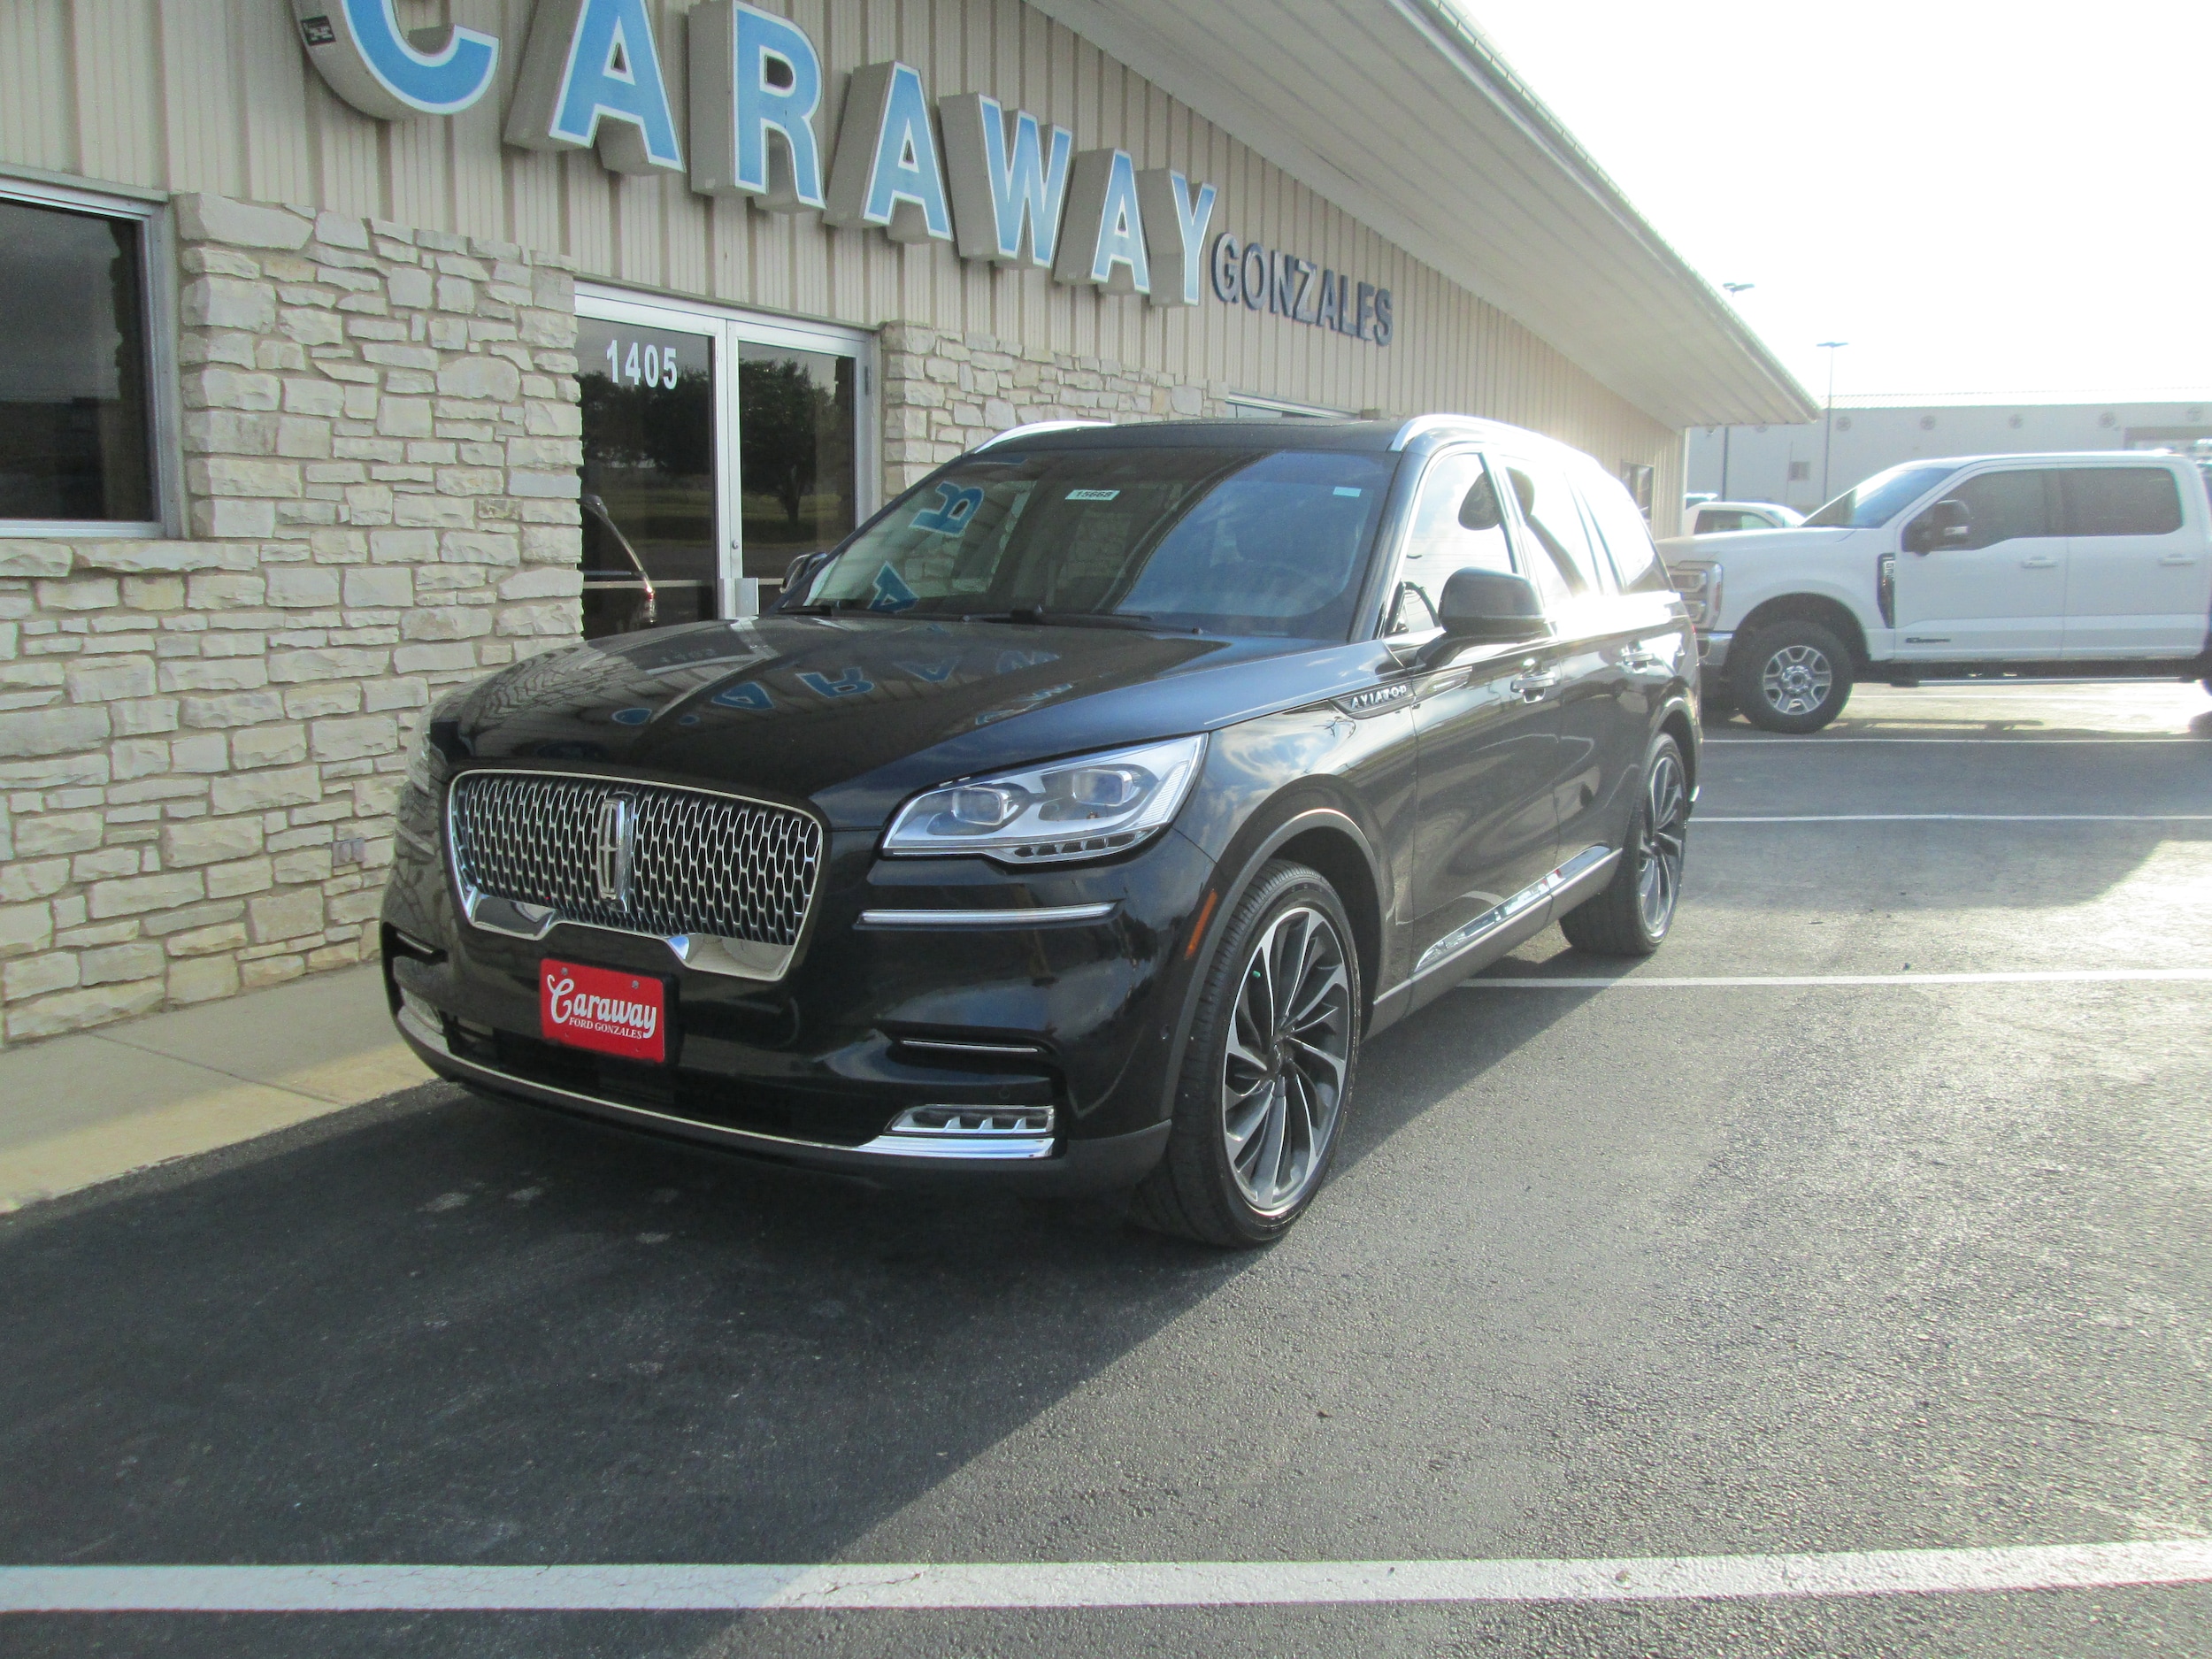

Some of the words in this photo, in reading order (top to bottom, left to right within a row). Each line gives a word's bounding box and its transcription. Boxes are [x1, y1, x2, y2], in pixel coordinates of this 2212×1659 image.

[1211, 232, 1394, 347] GONZALES
[606, 339, 678, 390] 1405
[547, 974, 657, 1039] Caraway
[569, 1018, 594, 1029] FORD
[595, 1022, 642, 1040] GONZALES
